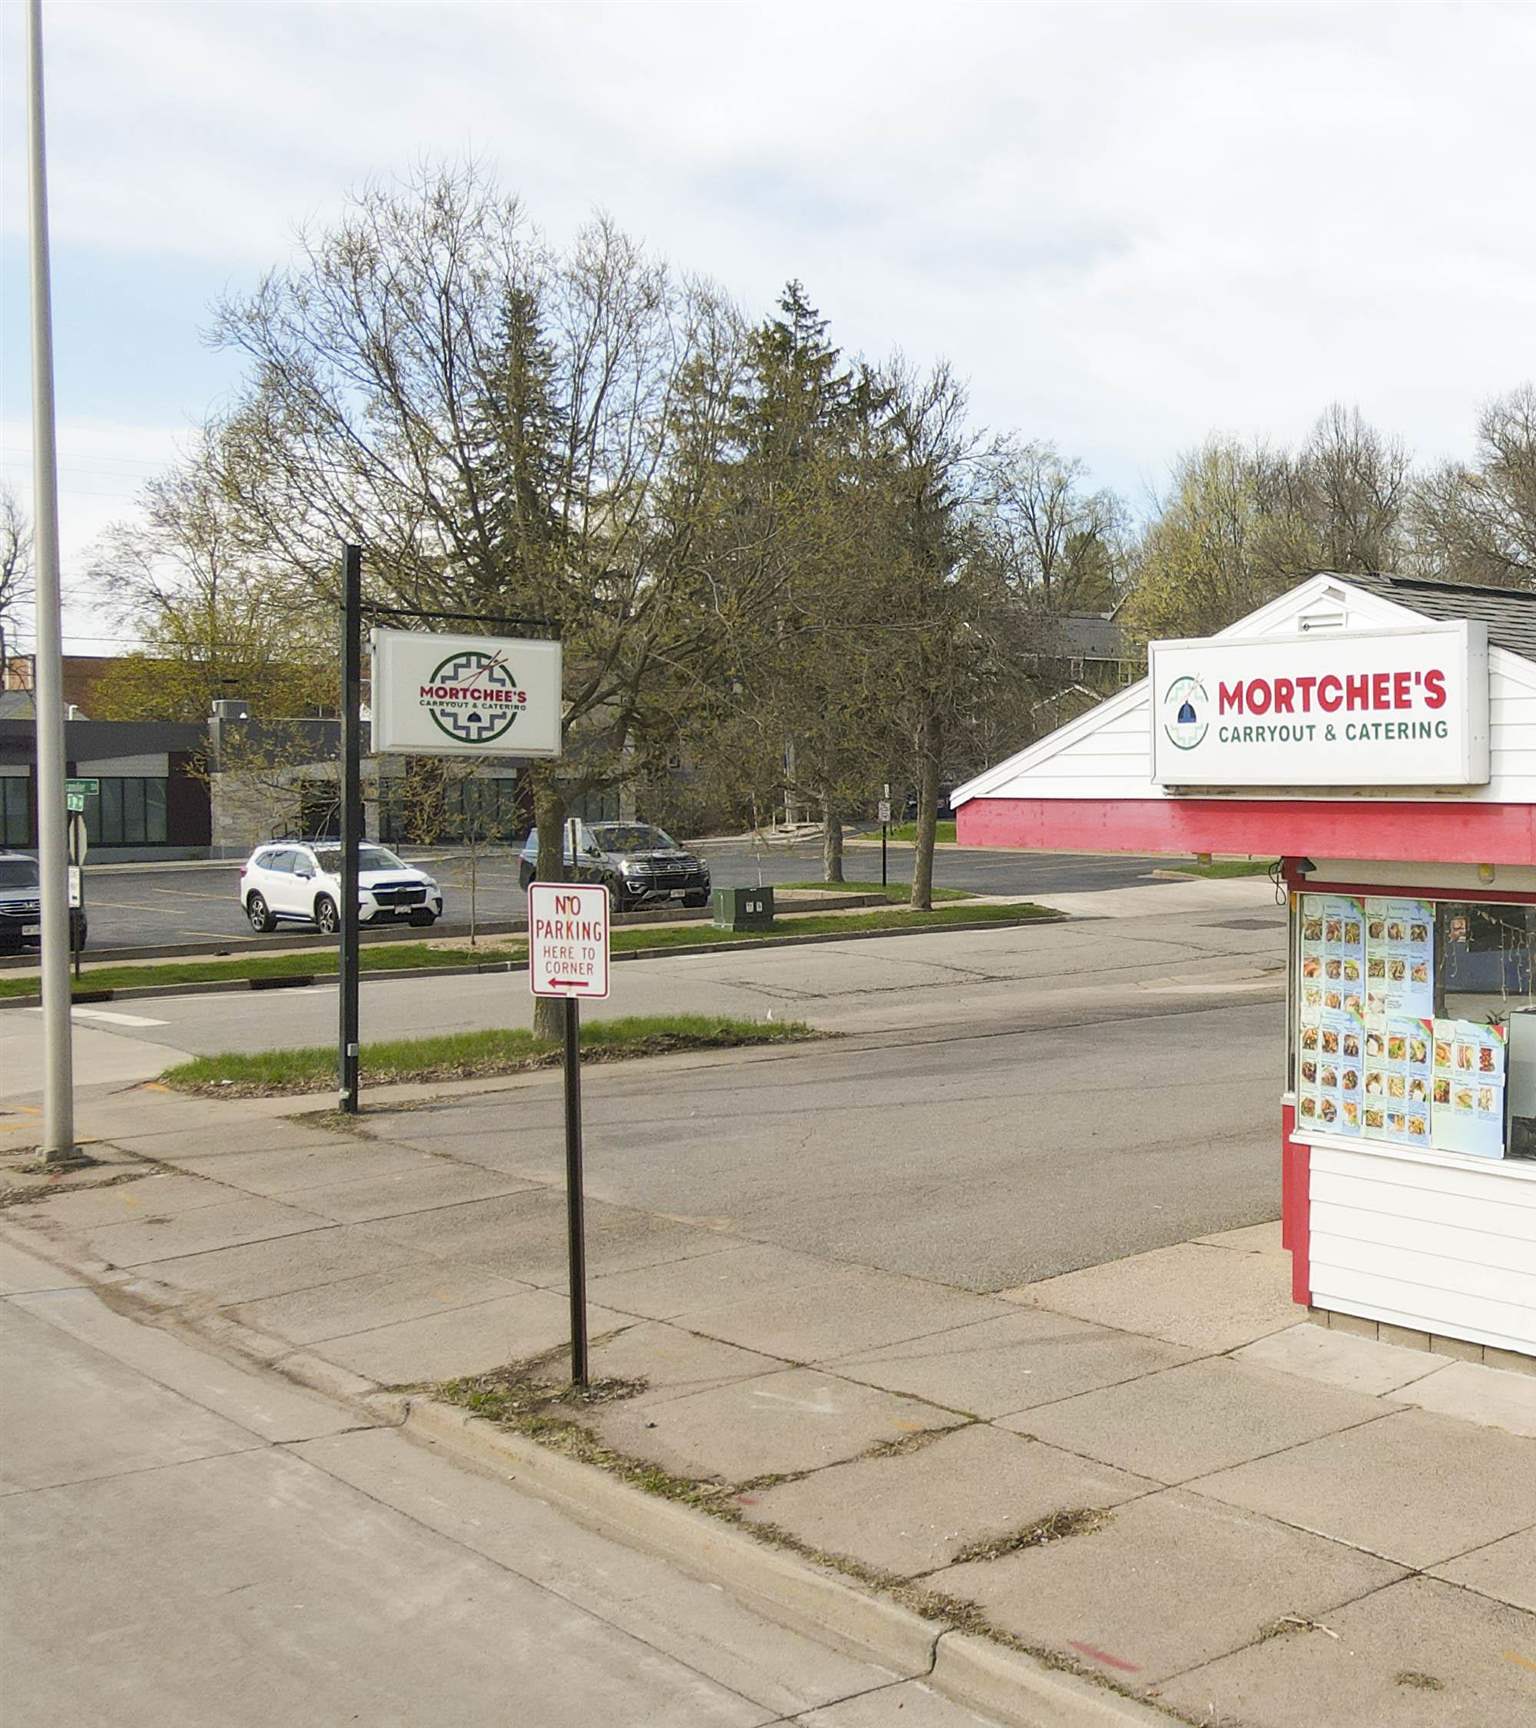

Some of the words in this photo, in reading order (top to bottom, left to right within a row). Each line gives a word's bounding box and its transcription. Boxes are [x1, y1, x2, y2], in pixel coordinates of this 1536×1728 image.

[419, 686, 527, 704] MORTCHEE'S
[1218, 669, 1447, 716] MORTCHEE'S
[419, 700, 469, 709] CARRYOUT
[482, 702, 527, 711] CATERING
[1218, 724, 1316, 743] CARRYOUT
[1324, 723, 1337, 742] &
[1345, 720, 1448, 741] CATERING
[555, 895, 581, 916] NO
[536, 919, 602, 942] PARKING
[543, 945, 575, 960] HERE
[582, 947, 596, 961] TO
[545, 960, 594, 977] CORNER
